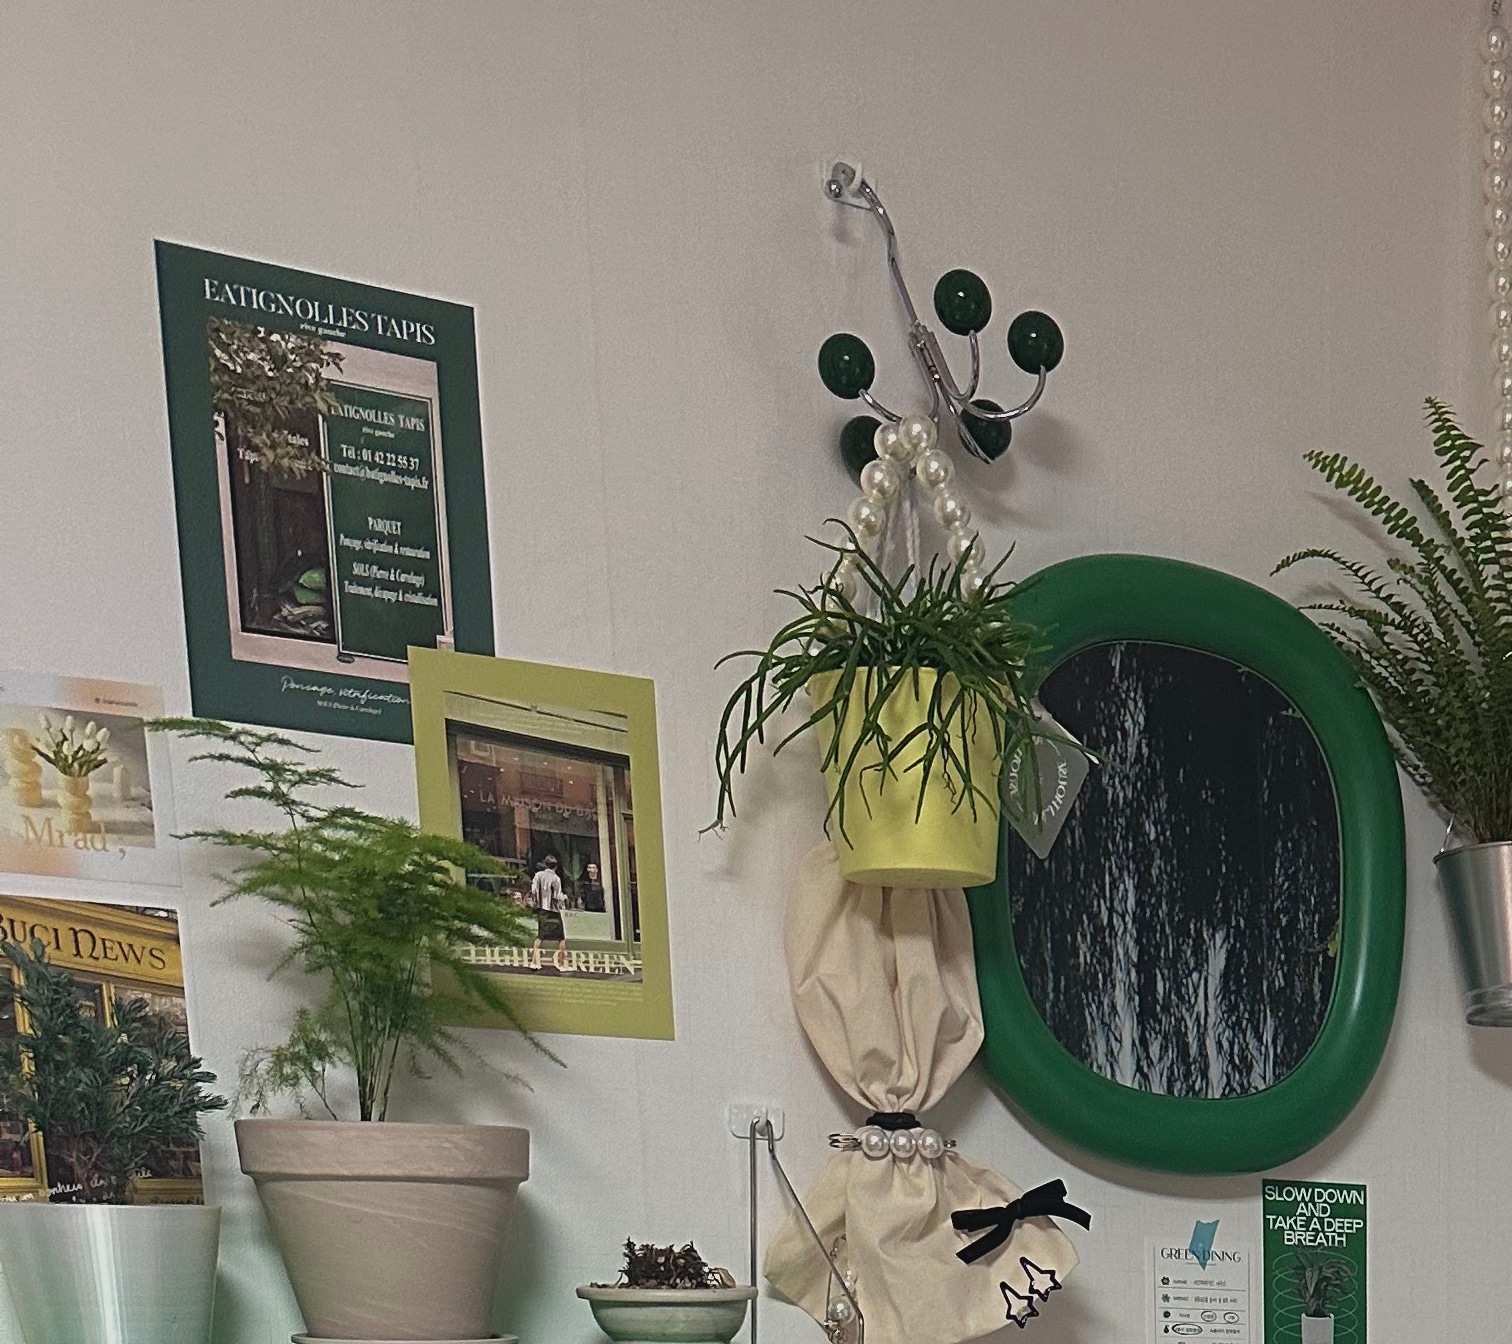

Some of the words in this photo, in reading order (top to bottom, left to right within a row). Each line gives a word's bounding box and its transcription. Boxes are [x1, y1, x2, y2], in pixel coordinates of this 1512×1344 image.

[204, 278, 368, 331] EATIGNOLLES
[370, 313, 436, 345] TAPIS
[398, 415, 425, 431] TAPIS
[362, 449, 371, 462] 01
[374, 451, 384, 464] 42
[386, 453, 396, 466] 22
[397, 455, 407, 469] 55
[409, 457, 419, 471] 37
[368, 516, 401, 536] PARQUET
[69, 925, 167, 971] NEWS
[553, 949, 635, 975] GREEN
[1265, 1186, 1312, 1202] SLOW
[1314, 1188, 1364, 1205] DOWN
[1296, 1202, 1331, 1218] AND
[1266, 1215, 1307, 1231] TAKE
[1309, 1217, 1321, 1232] A
[1324, 1219, 1364, 1233] DEEP
[1284, 1231, 1346, 1247] BREATH
[1161, 1247, 1198, 1260] GREE
